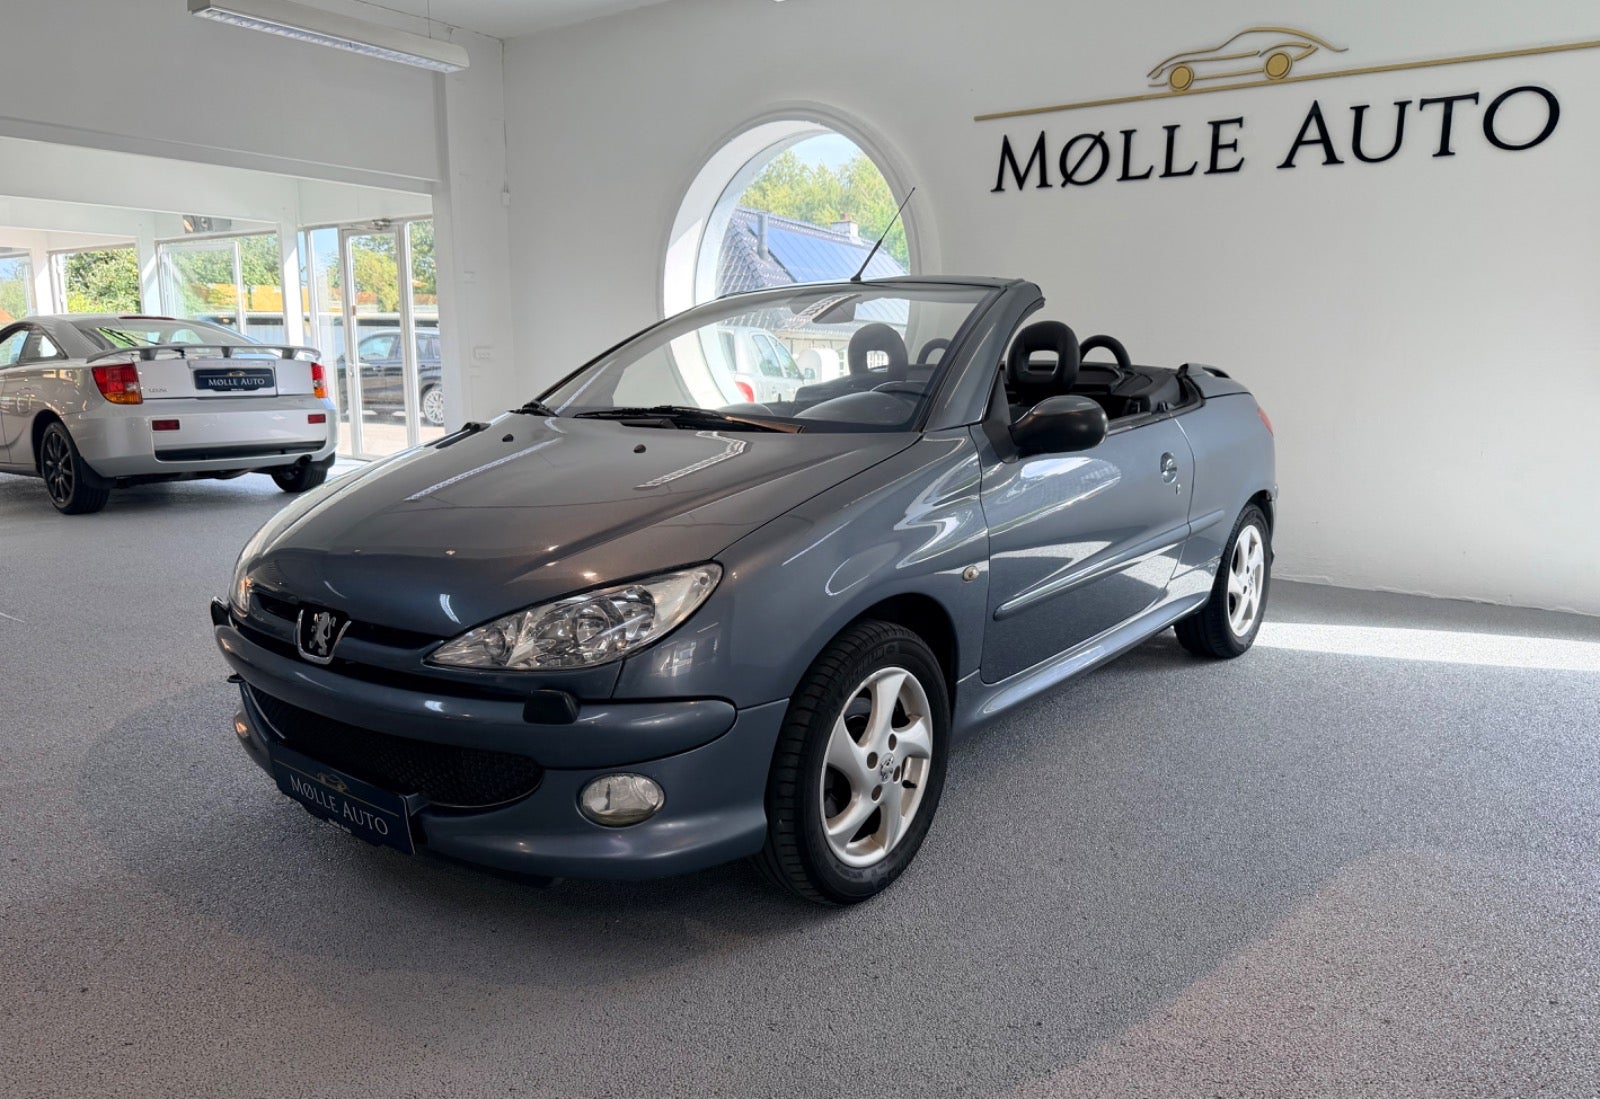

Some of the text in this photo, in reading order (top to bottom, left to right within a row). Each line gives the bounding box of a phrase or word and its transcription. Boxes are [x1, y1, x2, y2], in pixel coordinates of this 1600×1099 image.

[990, 85, 1561, 194] MØLLE AUTO
[240, 377, 265, 386] AUTO
[290, 774, 339, 814] MØLLE
[343, 801, 389, 836] AUTO
